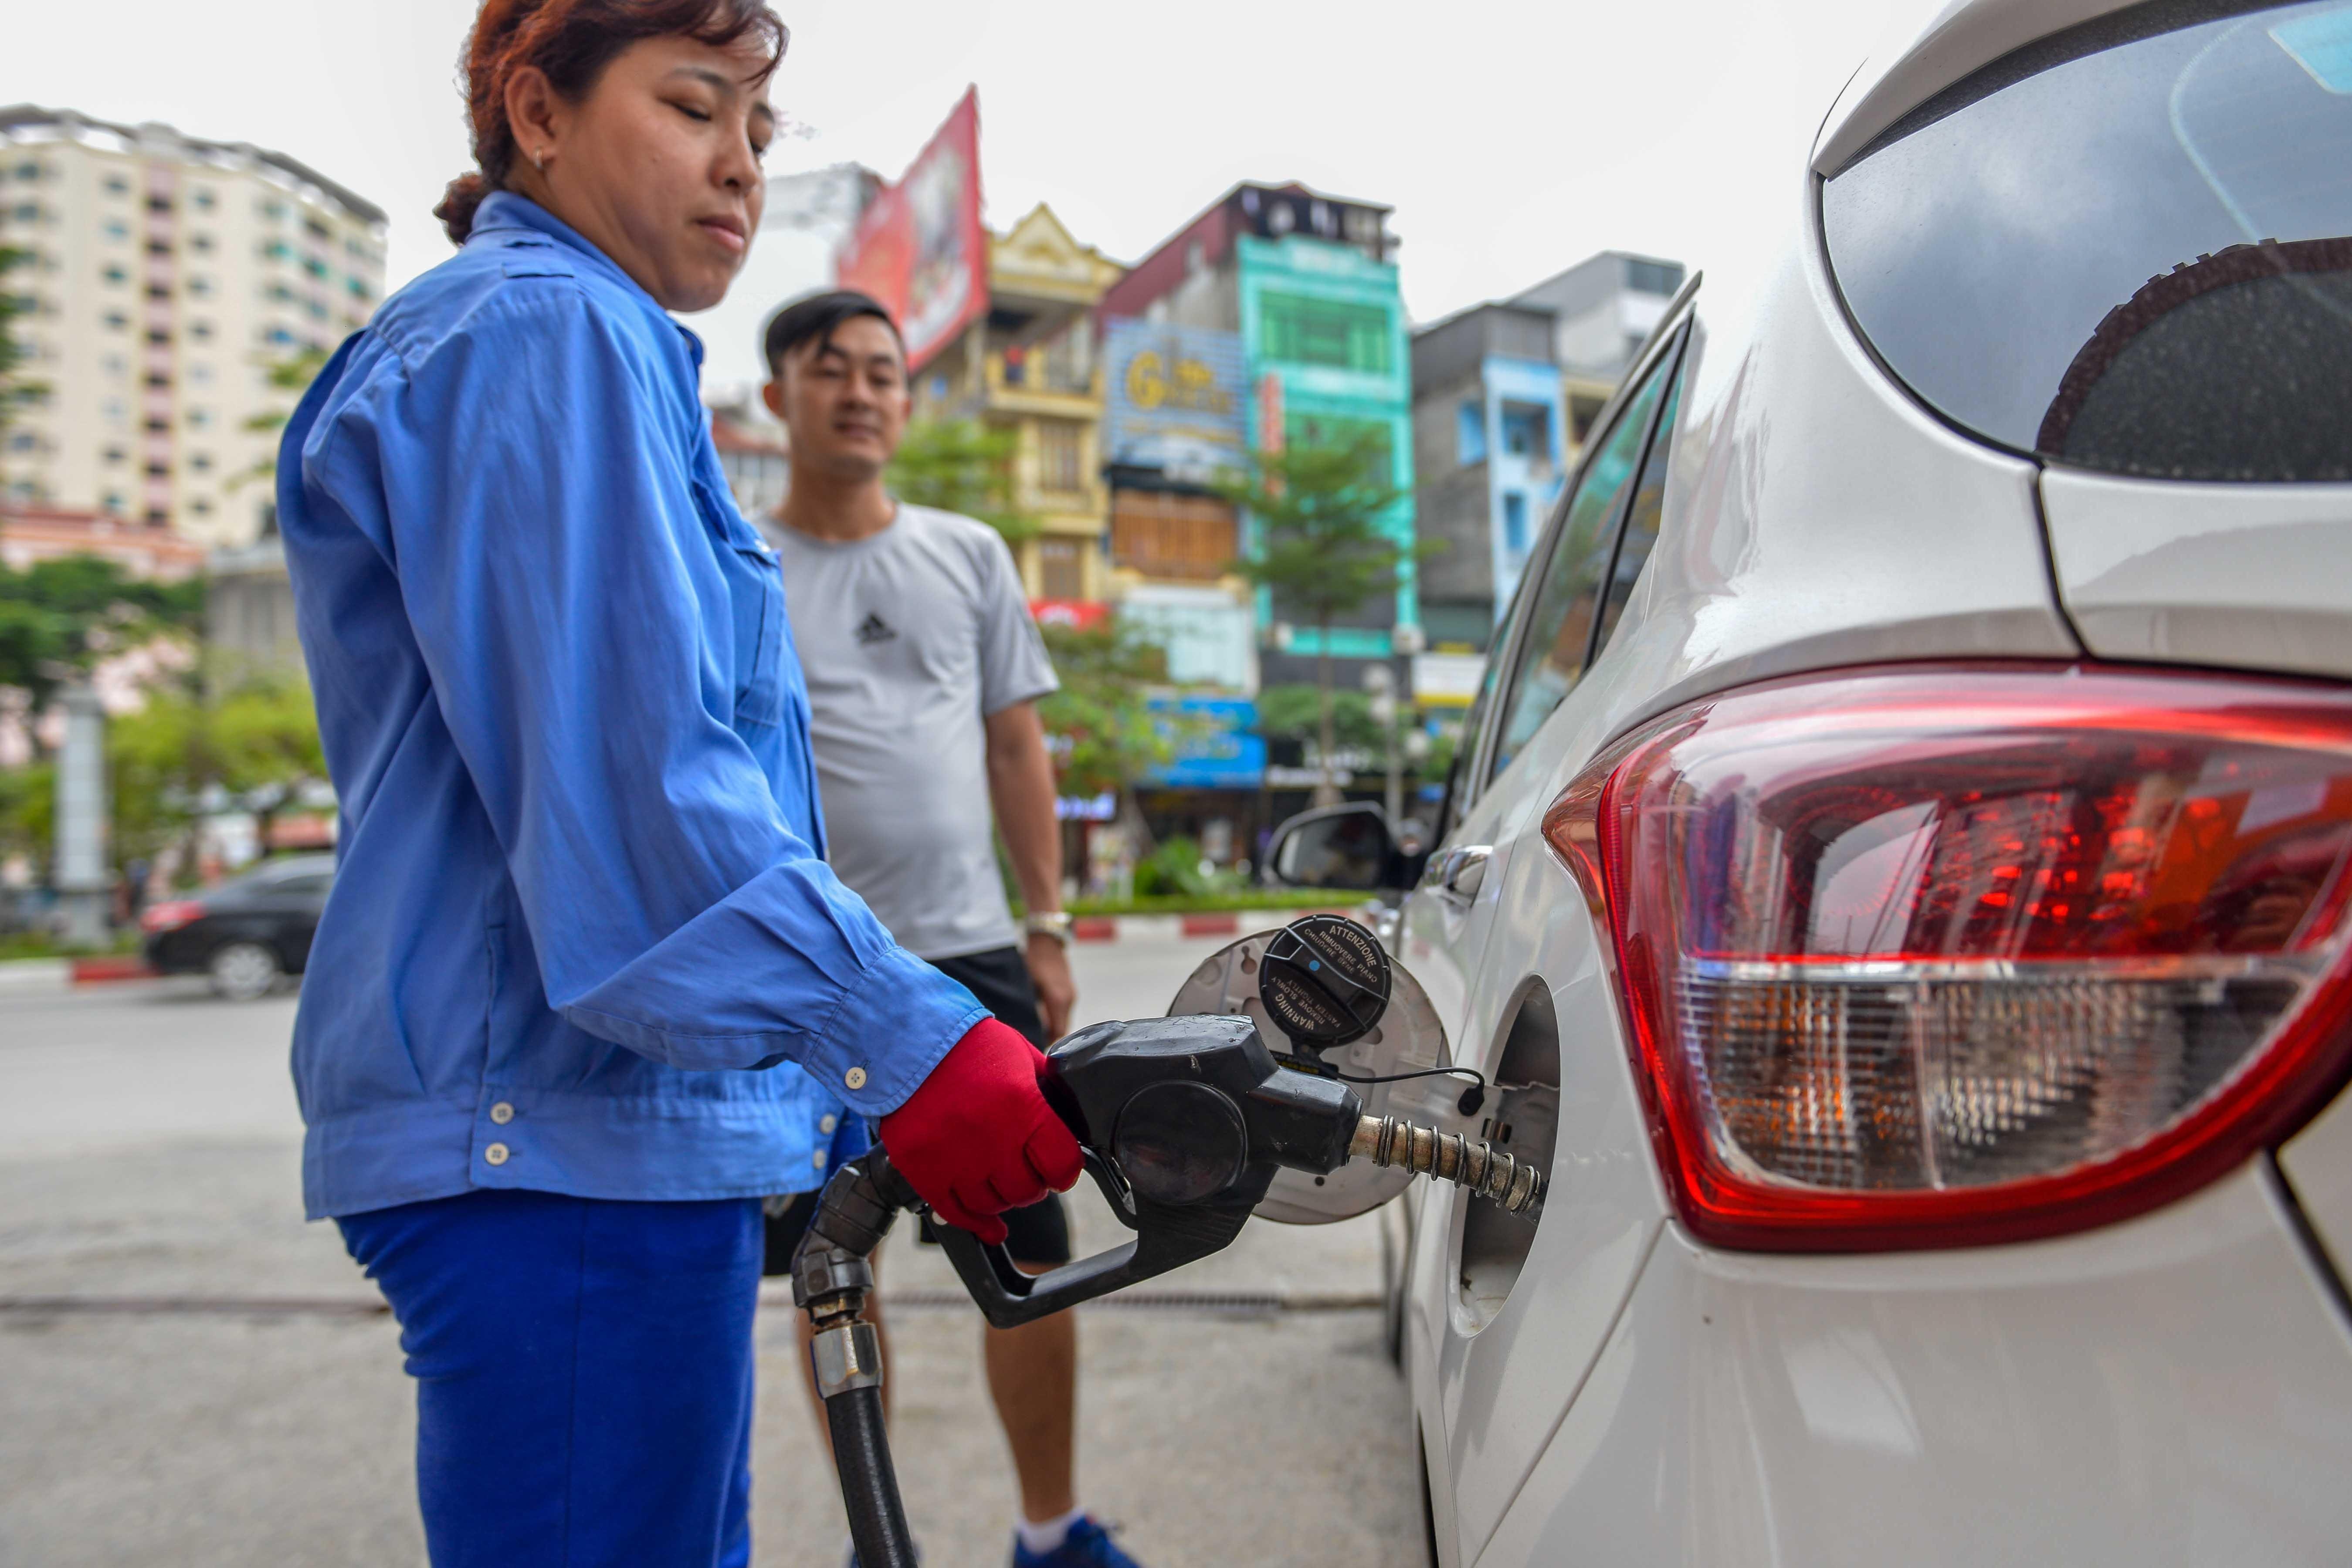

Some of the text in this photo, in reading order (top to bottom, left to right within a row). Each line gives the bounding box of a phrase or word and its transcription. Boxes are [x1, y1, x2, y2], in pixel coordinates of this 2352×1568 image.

[1304, 928, 1336, 958] CHIUDERE
[1319, 931, 1378, 983] RIMUOVERE PIANO
[1329, 925, 1377, 967] ATTENZIONE
[1271, 976, 1325, 1025] REMOVE SLOWLY
[1274, 993, 1314, 1030] WARNING
